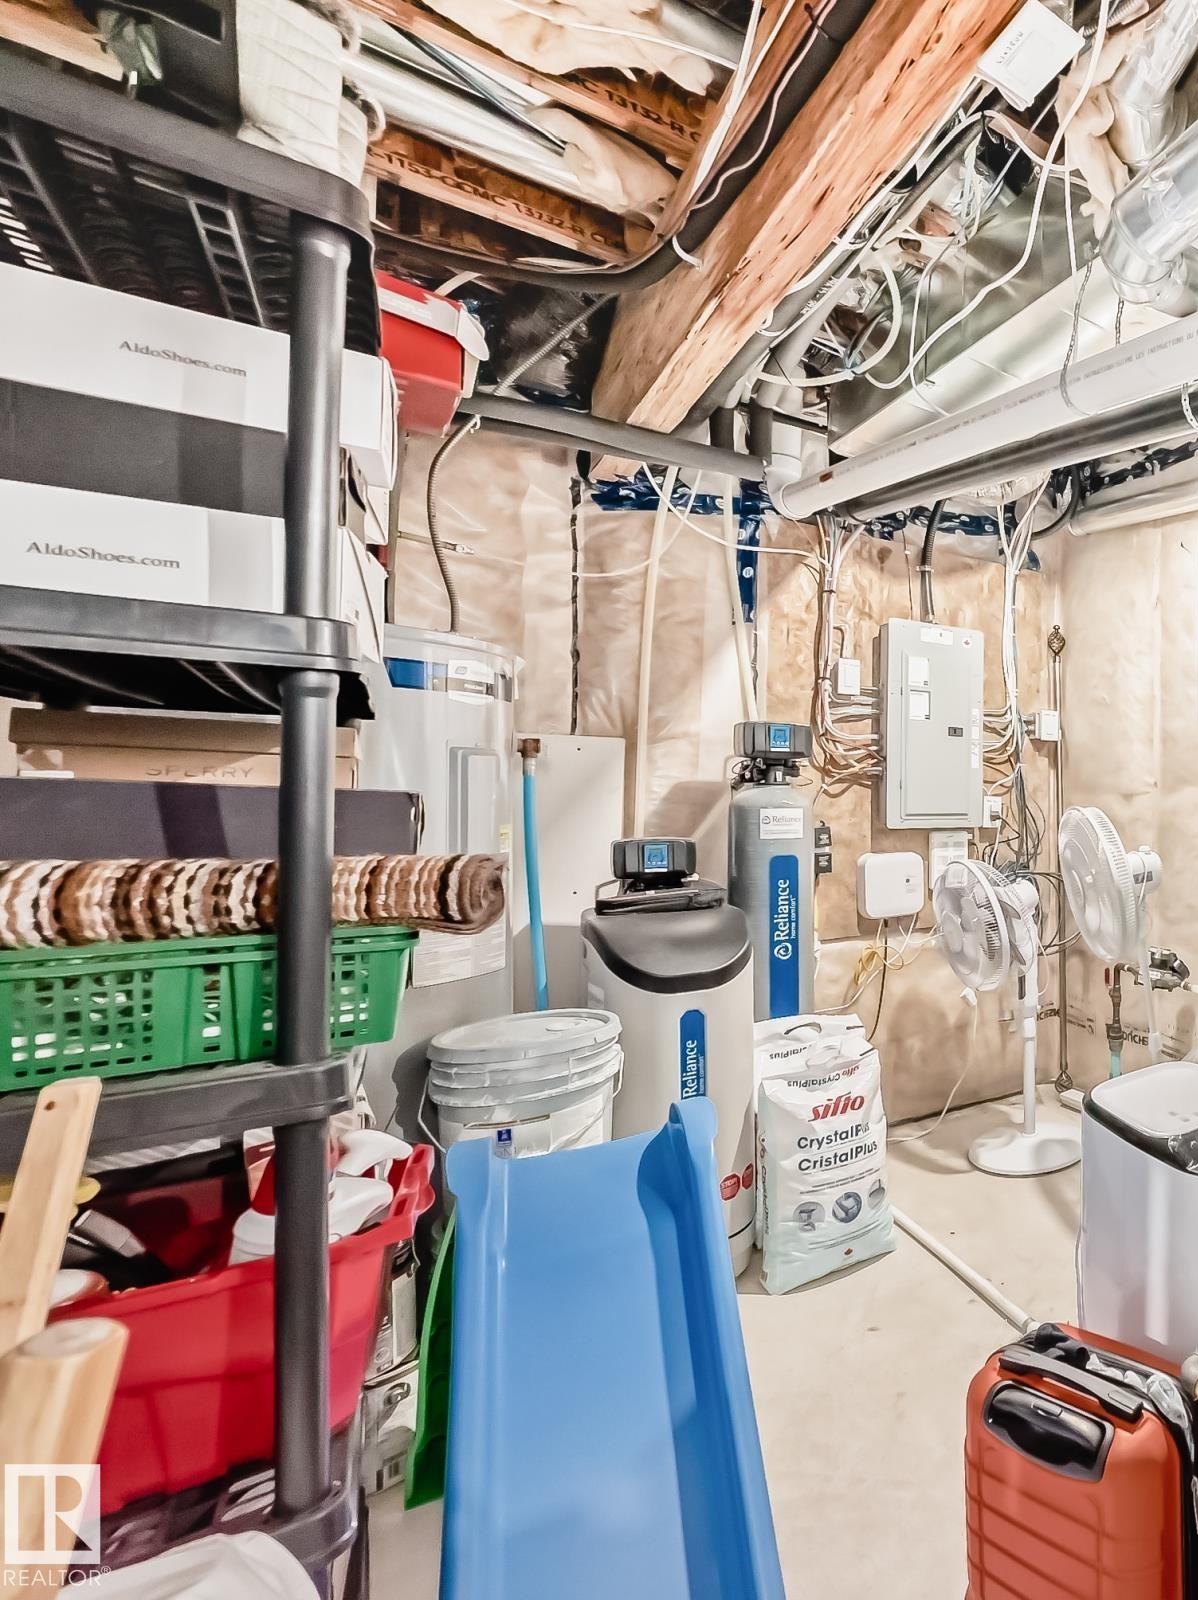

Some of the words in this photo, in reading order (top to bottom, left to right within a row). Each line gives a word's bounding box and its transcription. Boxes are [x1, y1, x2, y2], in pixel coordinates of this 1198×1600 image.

[120, 340, 247, 377] AldoShoes.com
[26, 541, 181, 570] AldoShoes.com
[774, 879, 790, 941] Reliance
[683, 1040, 698, 1099] Reliance
[808, 1091, 865, 1123] sifto
[798, 1140, 878, 1172] CristalPlus
